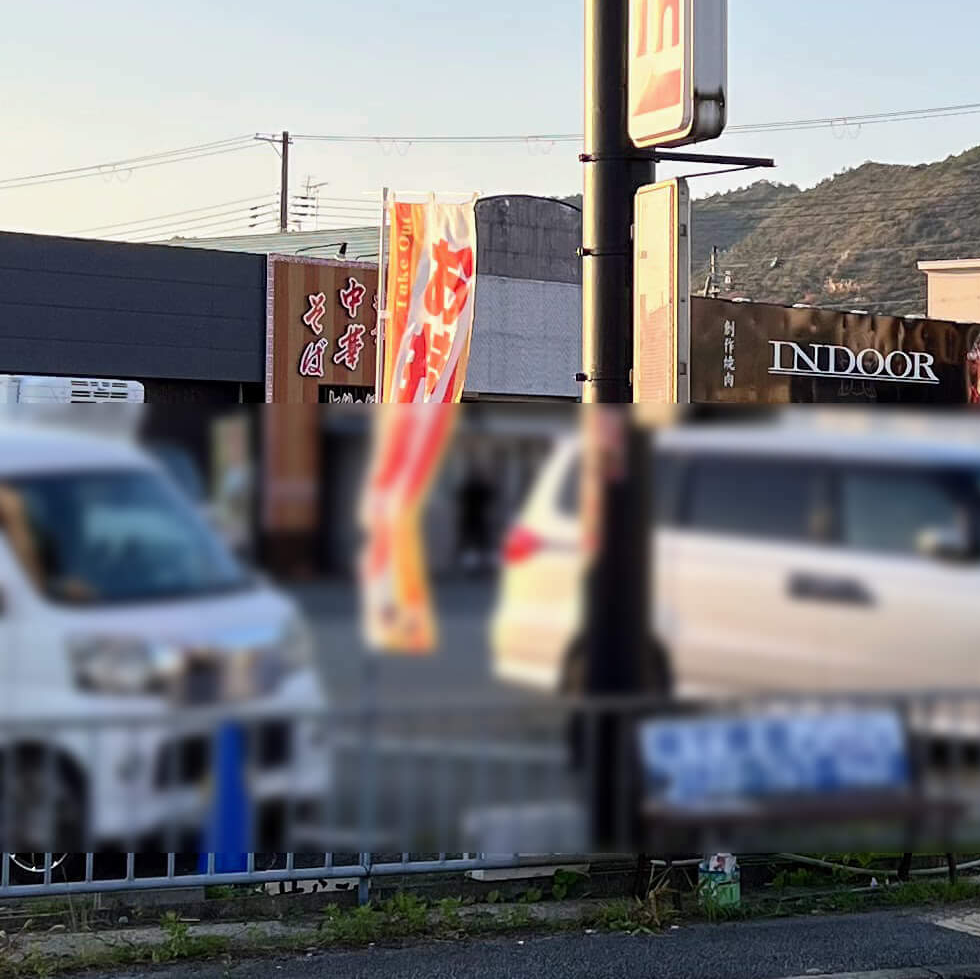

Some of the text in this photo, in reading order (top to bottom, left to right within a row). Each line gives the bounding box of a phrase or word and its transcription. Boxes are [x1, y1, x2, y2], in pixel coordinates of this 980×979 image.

[299, 291, 328, 378] そば
[333, 276, 366, 372] 中華
[722, 319, 737, 389] 創作焼肉
[768, 339, 940, 384] INDOOR
